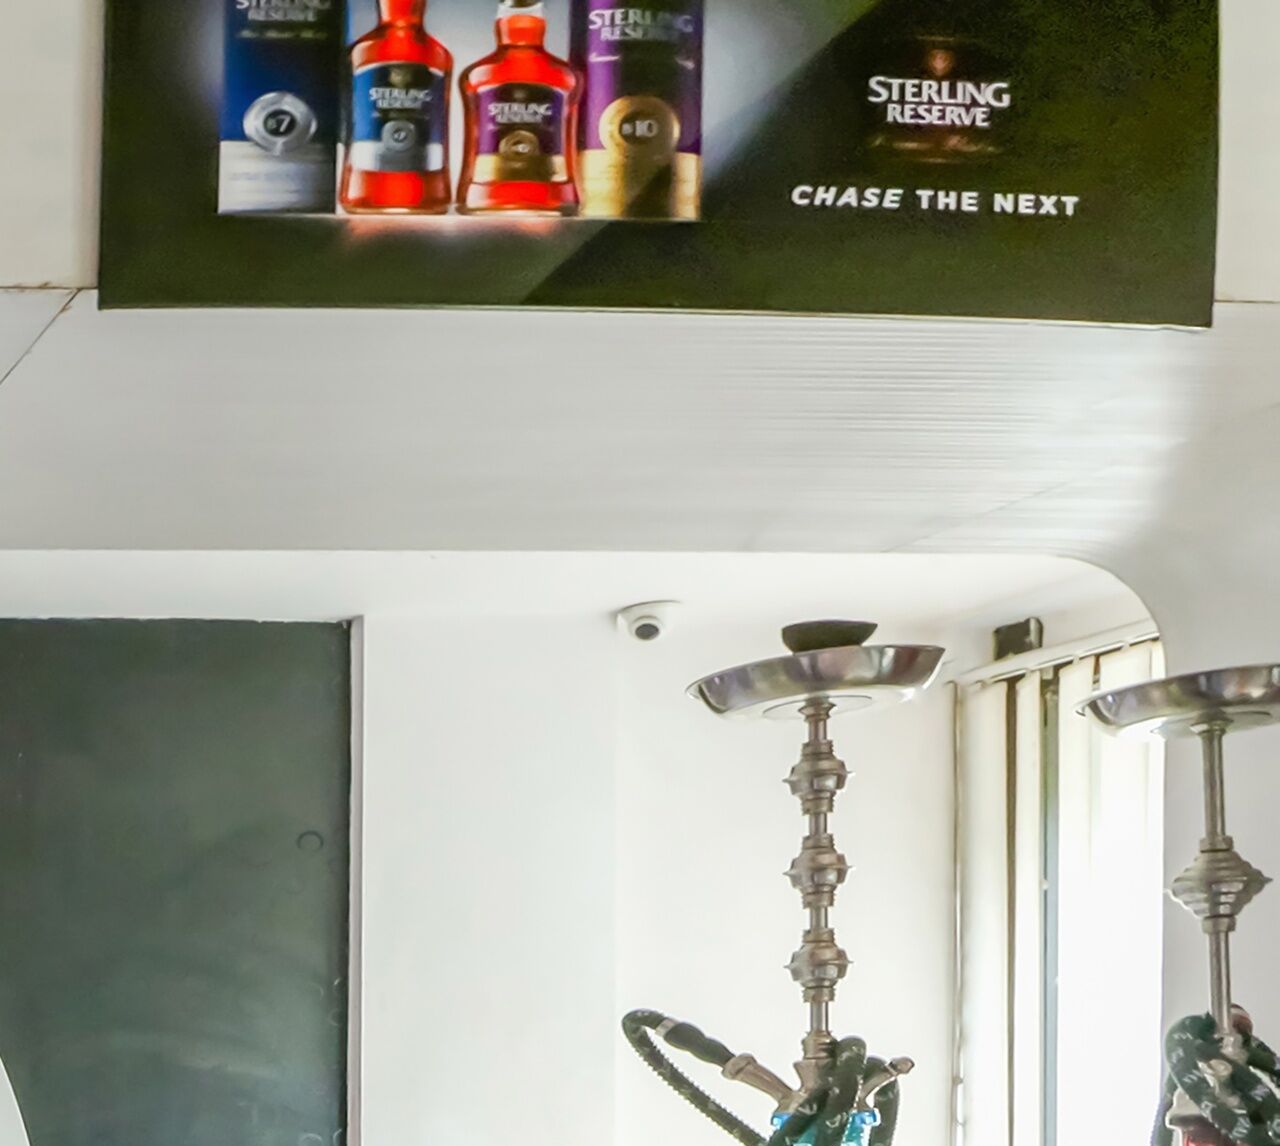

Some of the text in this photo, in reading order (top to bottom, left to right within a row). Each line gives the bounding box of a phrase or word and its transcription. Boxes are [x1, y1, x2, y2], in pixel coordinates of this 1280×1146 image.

[867, 76, 1011, 108] STERLING
[886, 103, 991, 127] RESERVE
[791, 184, 1079, 216] CHASE THE NEXT
